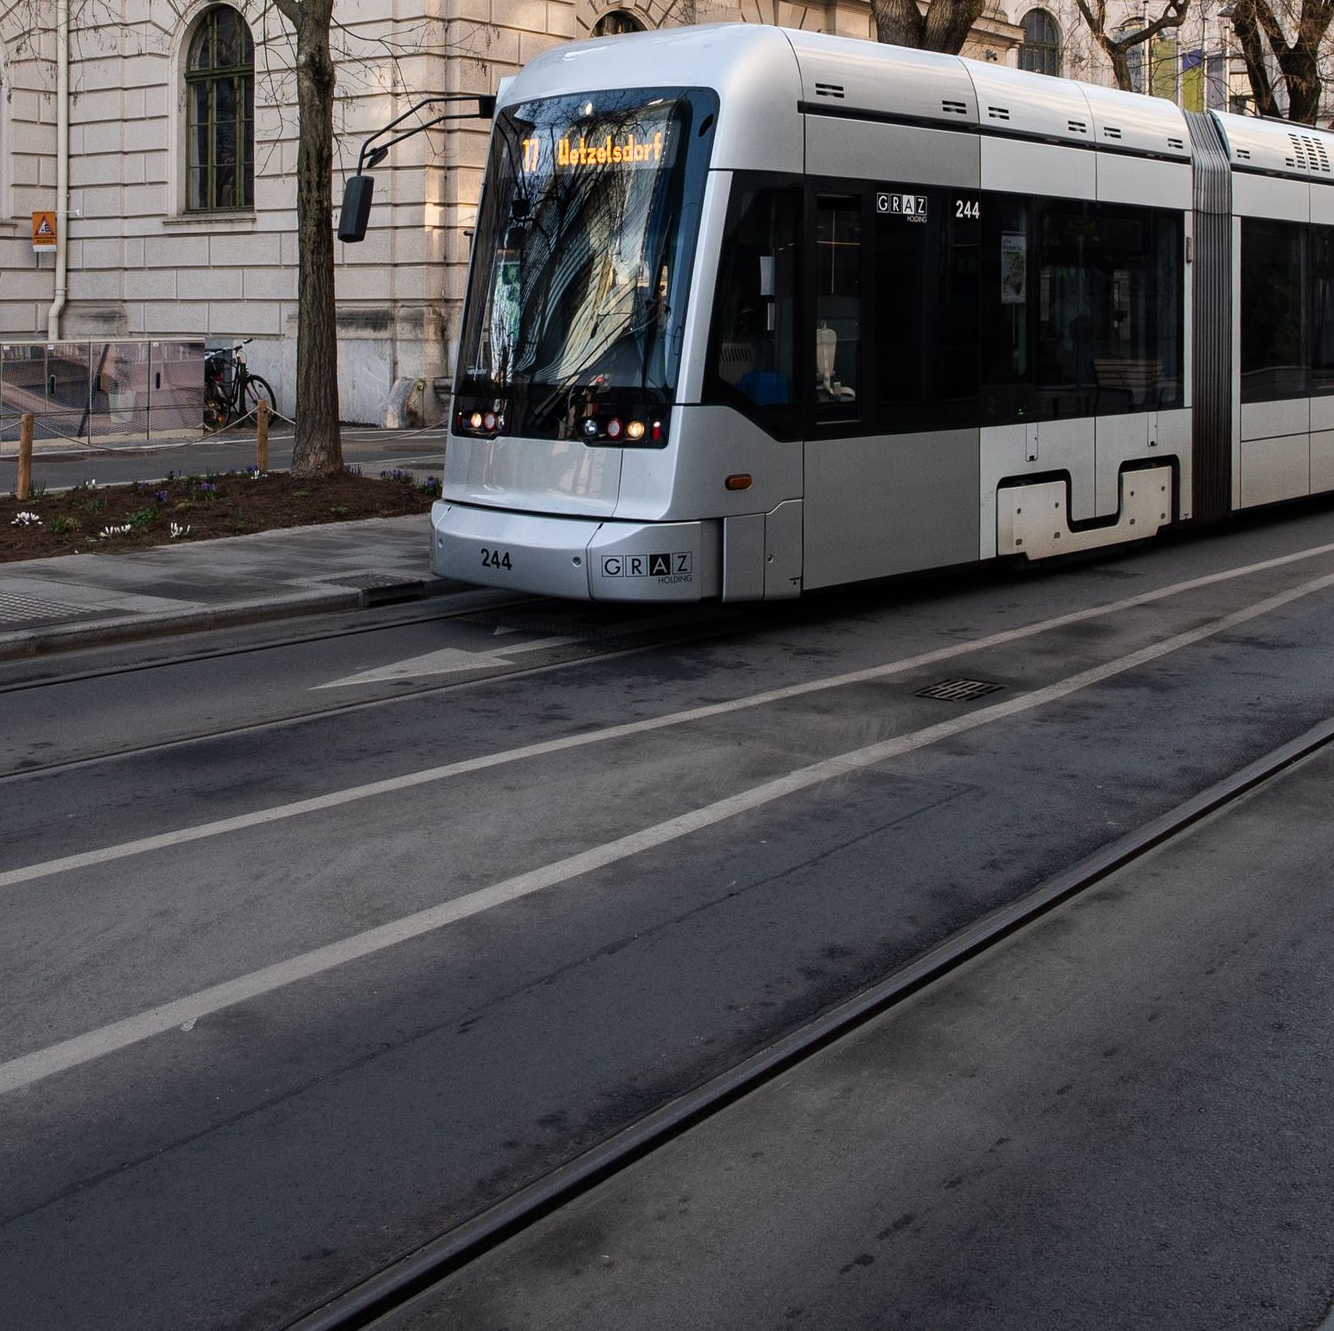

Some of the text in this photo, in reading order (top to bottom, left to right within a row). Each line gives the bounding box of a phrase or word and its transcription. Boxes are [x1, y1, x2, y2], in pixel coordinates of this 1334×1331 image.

[522, 132, 662, 172] 17 Wetzelsdorf
[877, 194, 926, 215] GRAZ
[955, 199, 980, 219] 244
[480, 548, 512, 570] 244
[602, 553, 690, 577] GRAZ
[658, 573, 693, 584] HOLDING
